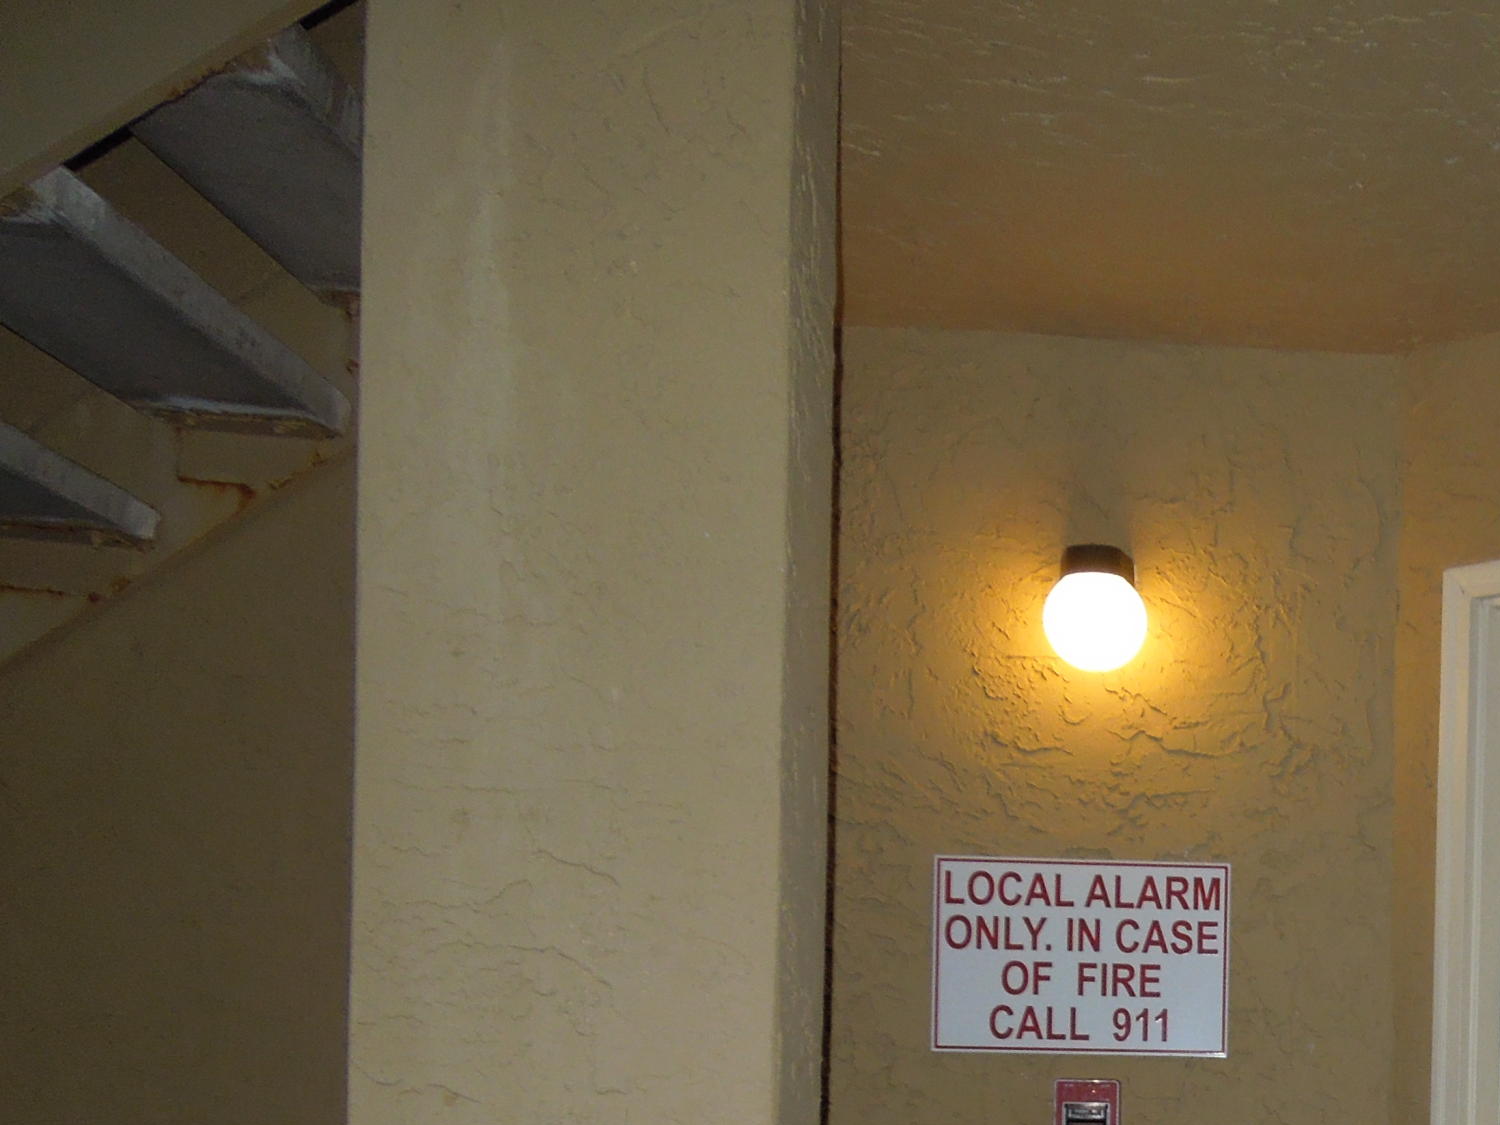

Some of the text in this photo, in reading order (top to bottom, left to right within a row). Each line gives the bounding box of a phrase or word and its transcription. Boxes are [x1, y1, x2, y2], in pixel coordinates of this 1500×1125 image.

[945, 870, 1221, 911] LOCAL ALARM
[945, 914, 1219, 955] ONLY. IN CASE
[1001, 960, 1162, 998] OF FIRE
[989, 1004, 1169, 1042] CALL 911
